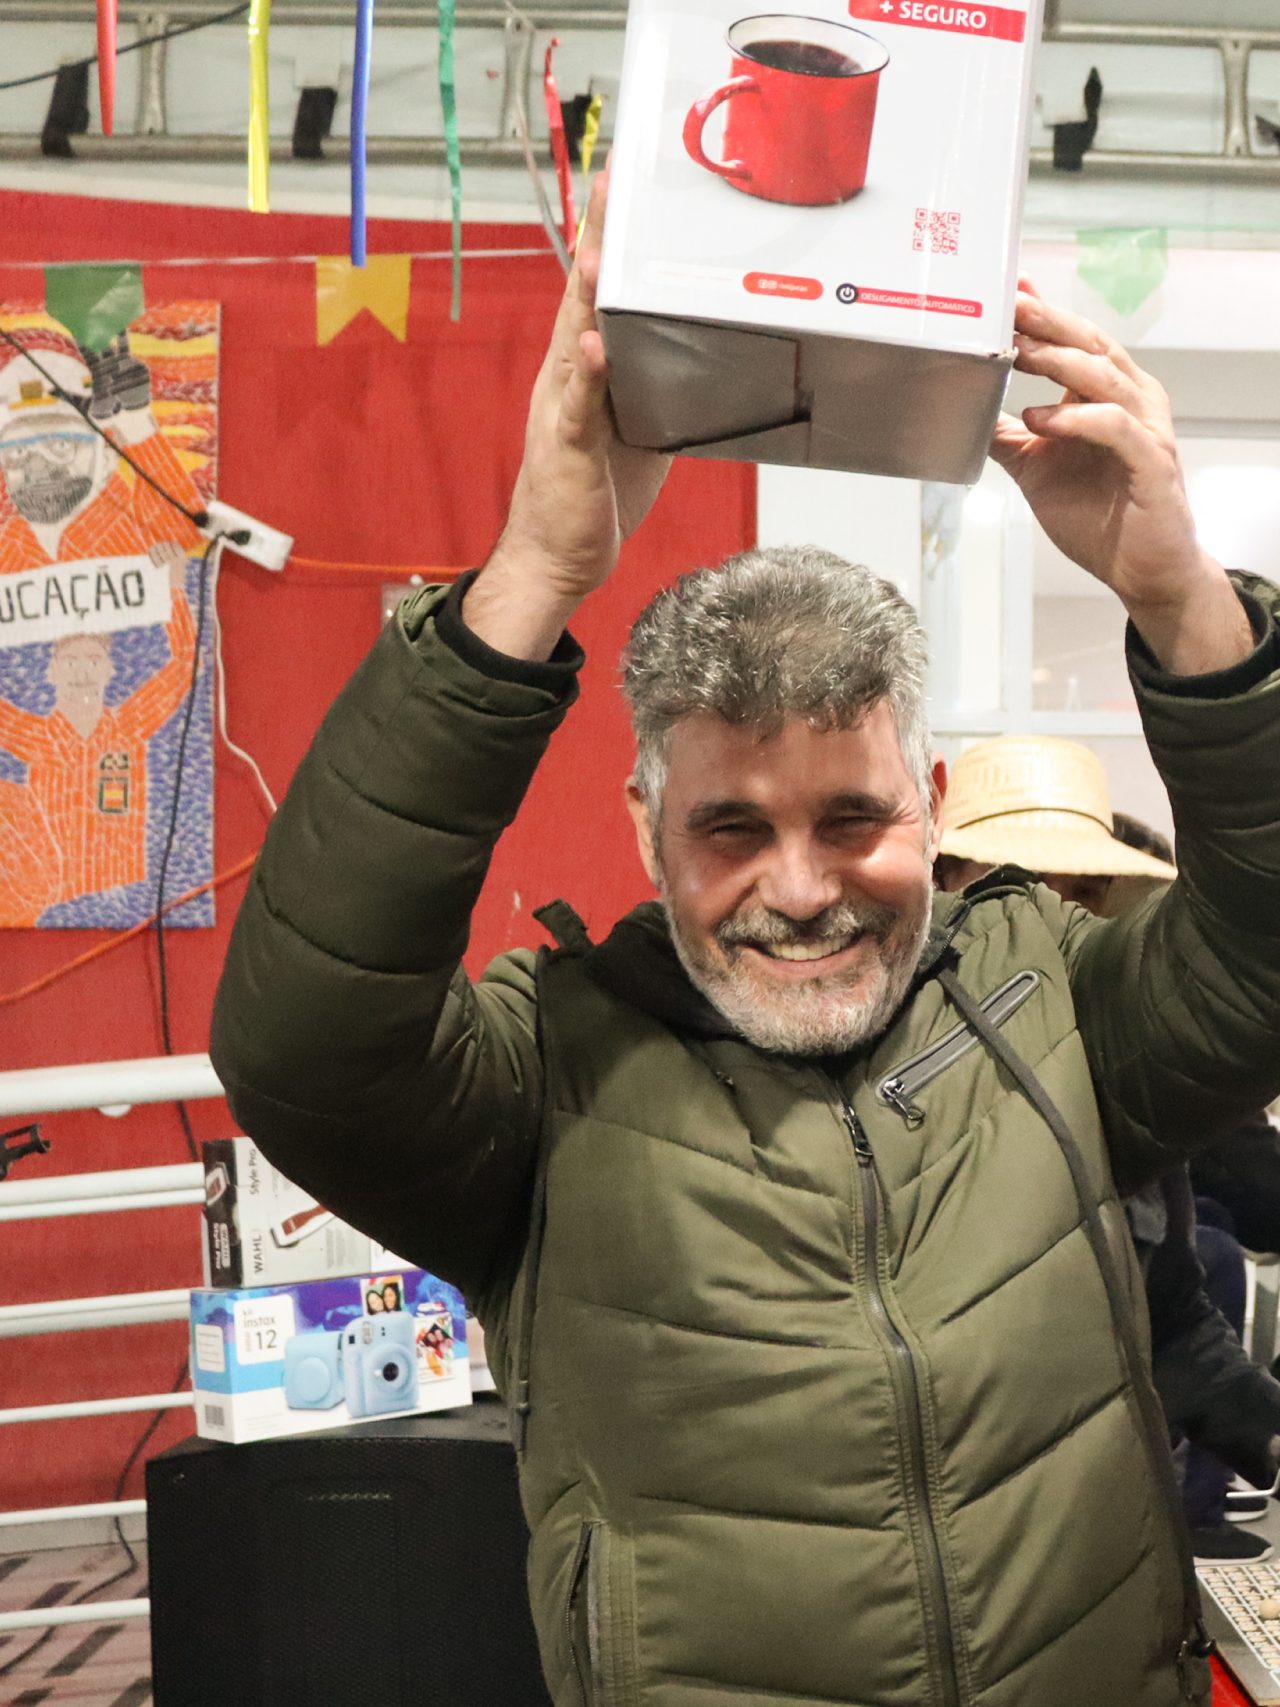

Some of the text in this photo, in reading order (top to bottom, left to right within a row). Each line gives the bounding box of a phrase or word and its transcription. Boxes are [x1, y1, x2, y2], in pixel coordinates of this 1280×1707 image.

[899, 1, 987, 29] SEGURO
[861, 292, 921, 307] DESLIGAMENTO
[248, 1149, 261, 1195] Style Pro
[253, 1234, 263, 1274] WAHL
[243, 1316, 276, 1329] instax
[255, 1329, 277, 1350] 12
